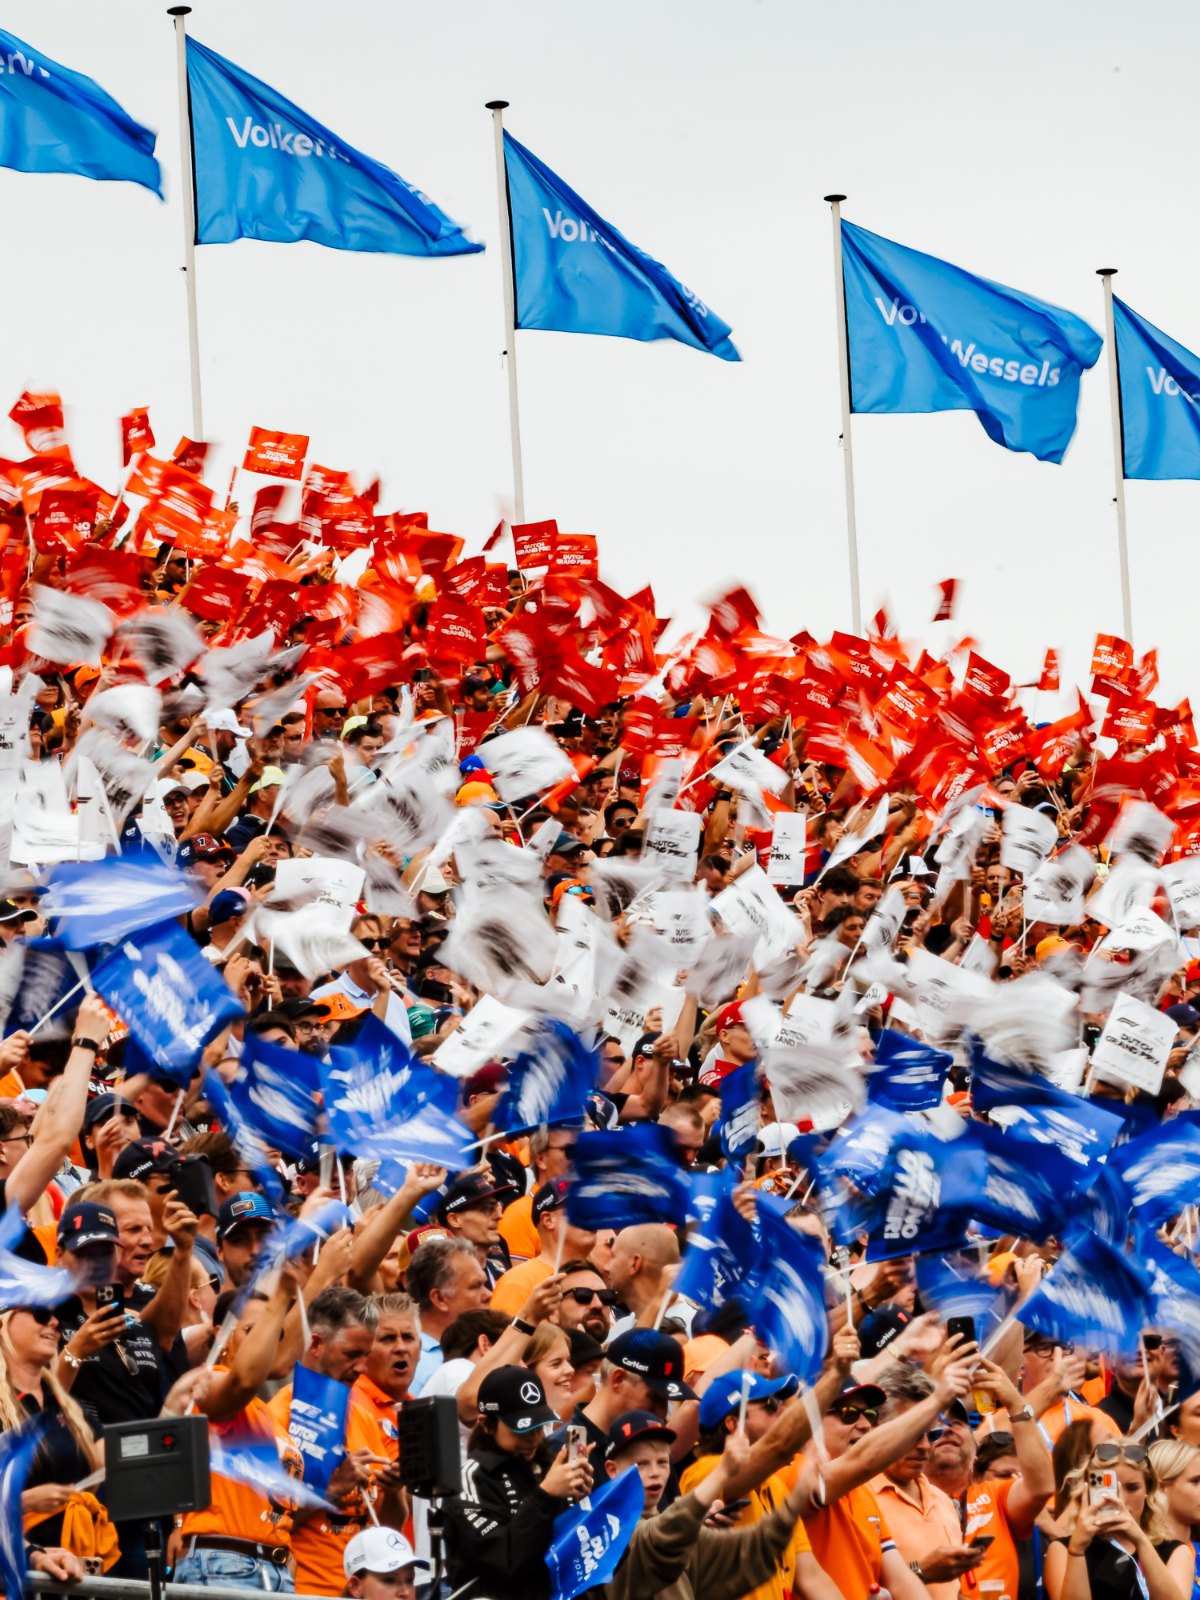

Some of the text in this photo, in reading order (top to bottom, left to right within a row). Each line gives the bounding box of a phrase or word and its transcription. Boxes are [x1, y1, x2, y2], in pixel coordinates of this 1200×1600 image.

[1105, 1035, 1138, 1055] GRAND
[1121, 1033, 1154, 1052] DUTCH
[74, 1215, 83, 1230] 1
[622, 1357, 649, 1372] CarNext
[517, 1417, 532, 1429] 63
